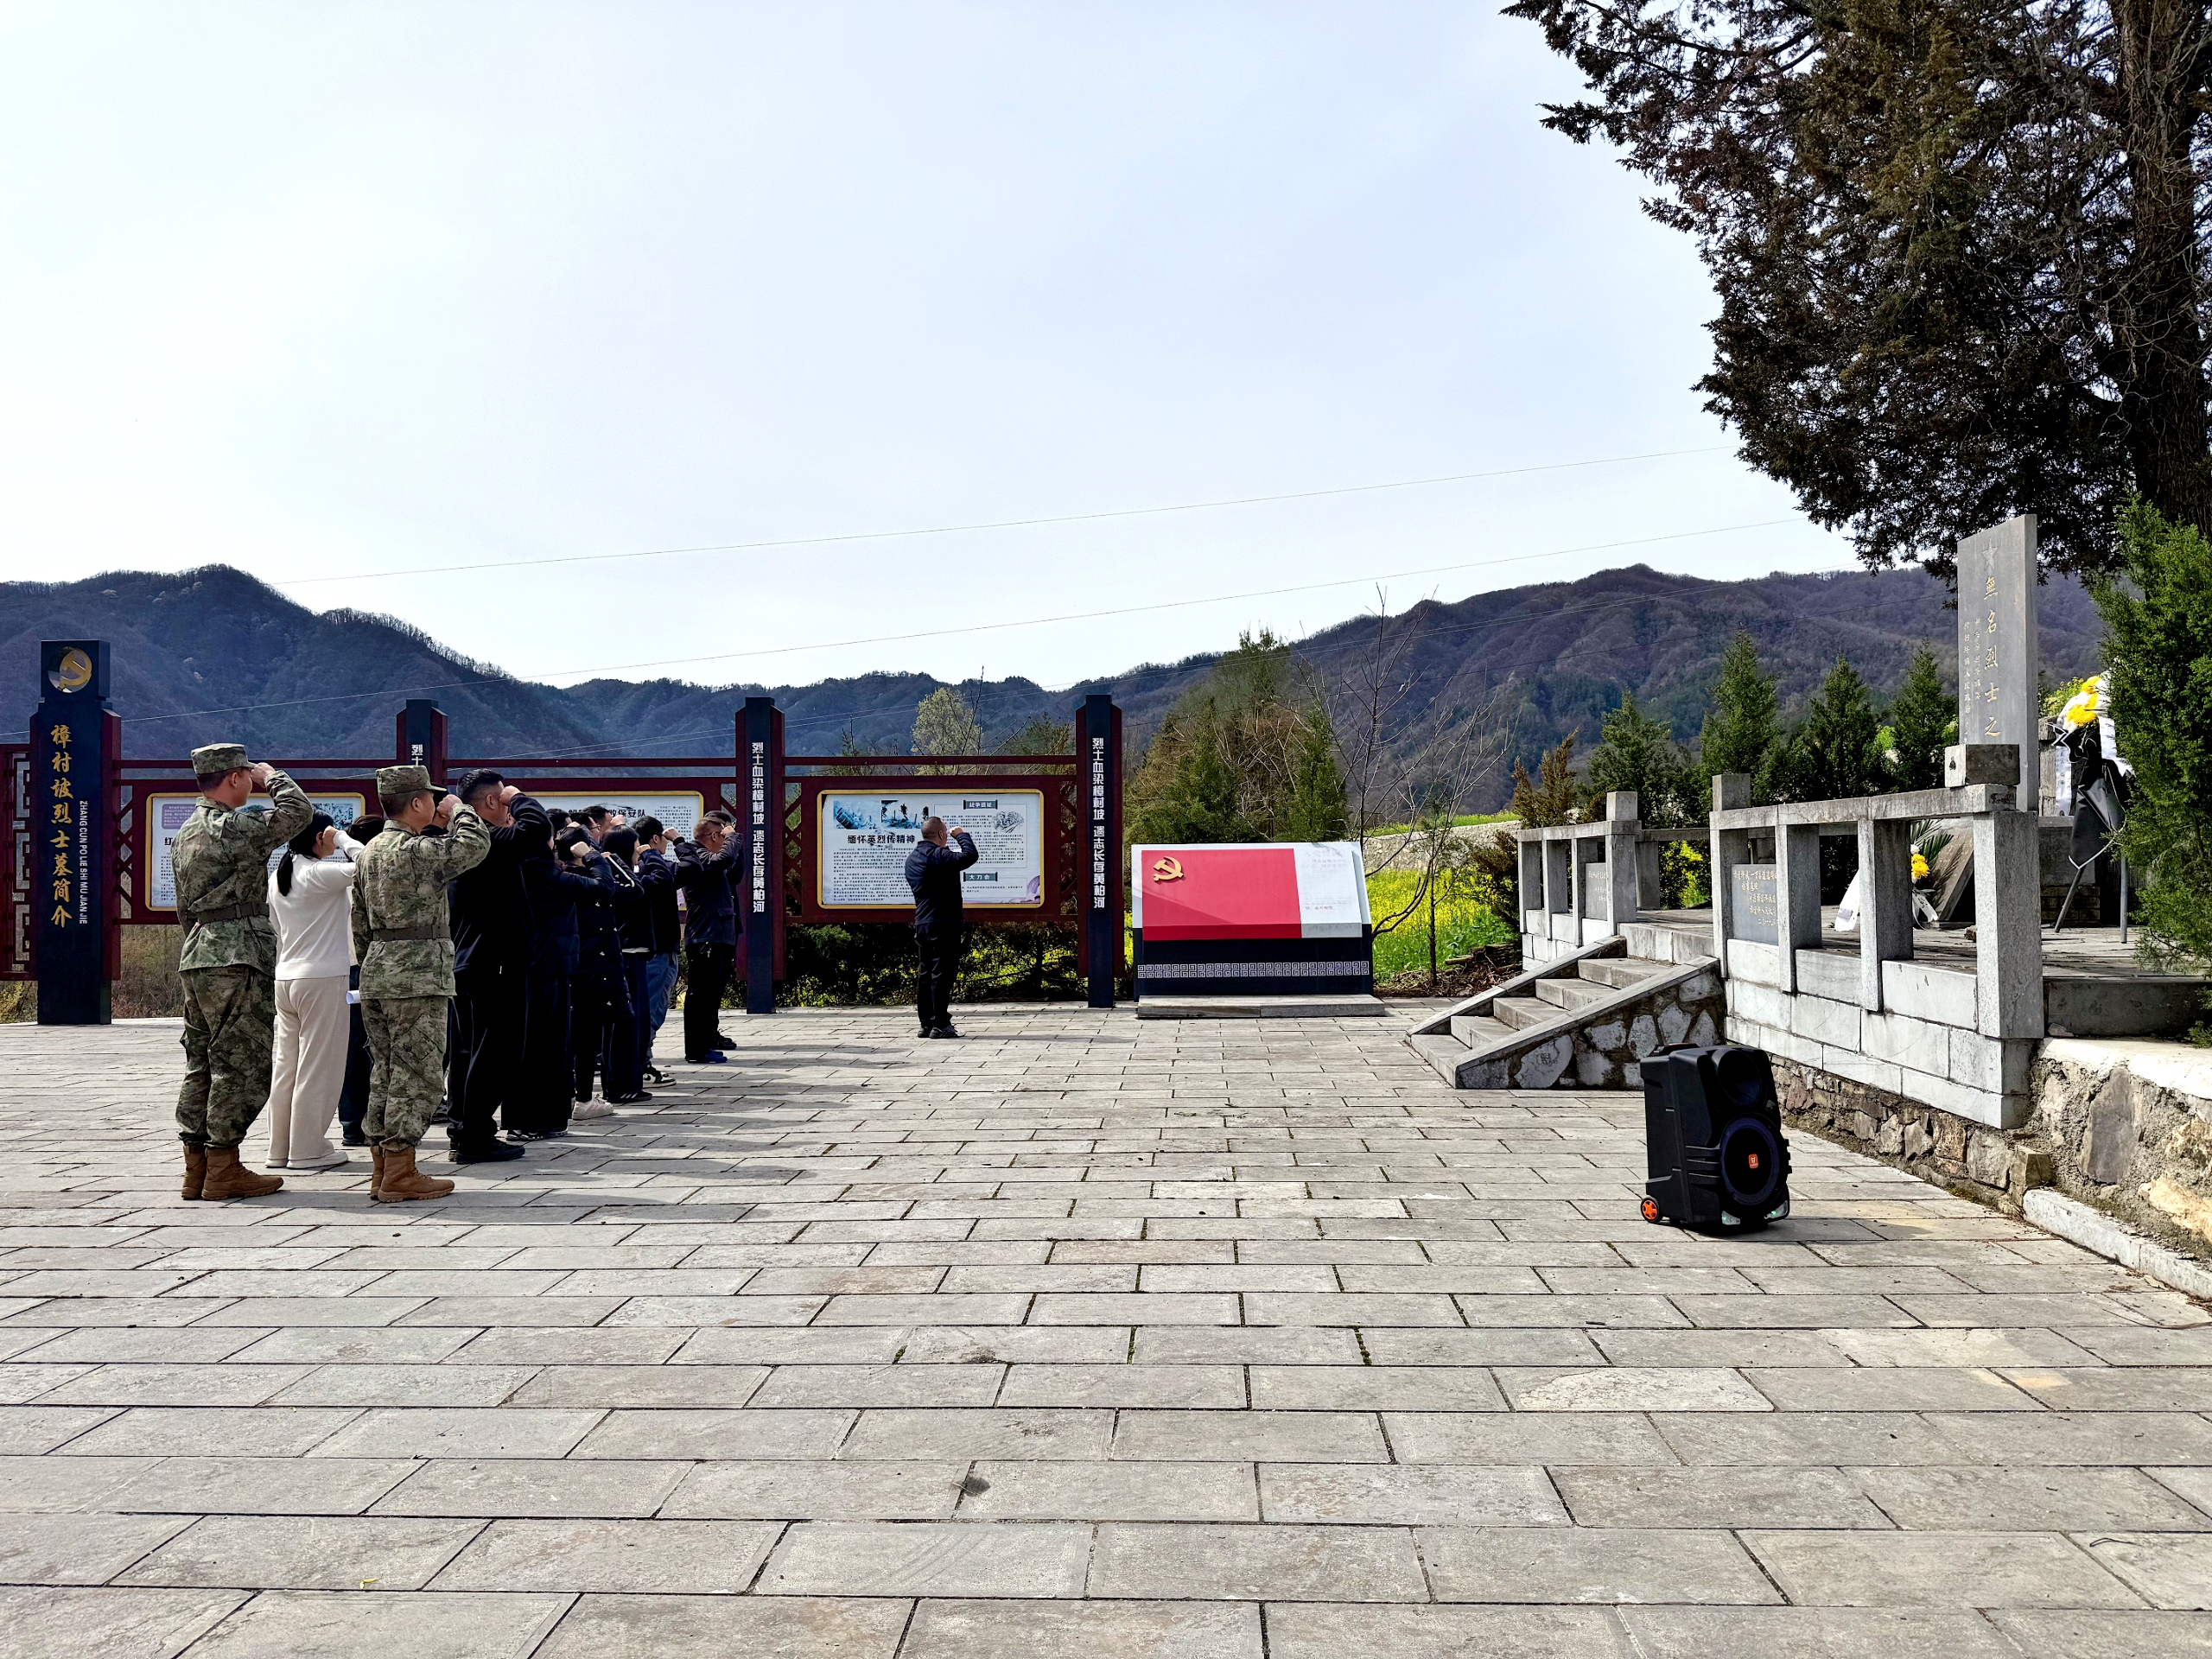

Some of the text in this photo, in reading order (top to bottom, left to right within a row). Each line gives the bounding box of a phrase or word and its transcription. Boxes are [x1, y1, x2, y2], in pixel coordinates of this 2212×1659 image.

[50, 724, 73, 928] 樟村坡烈士墓简介
[79, 800, 89, 925] ZHANG CUN PO LIE SHI MU JIAN JIE
[752, 741, 766, 913] 烈士血染樟村坡 遗志长存黄柏河
[1092, 737, 1106, 909] 烈士血染樟村坡 遗志长存黄柏河
